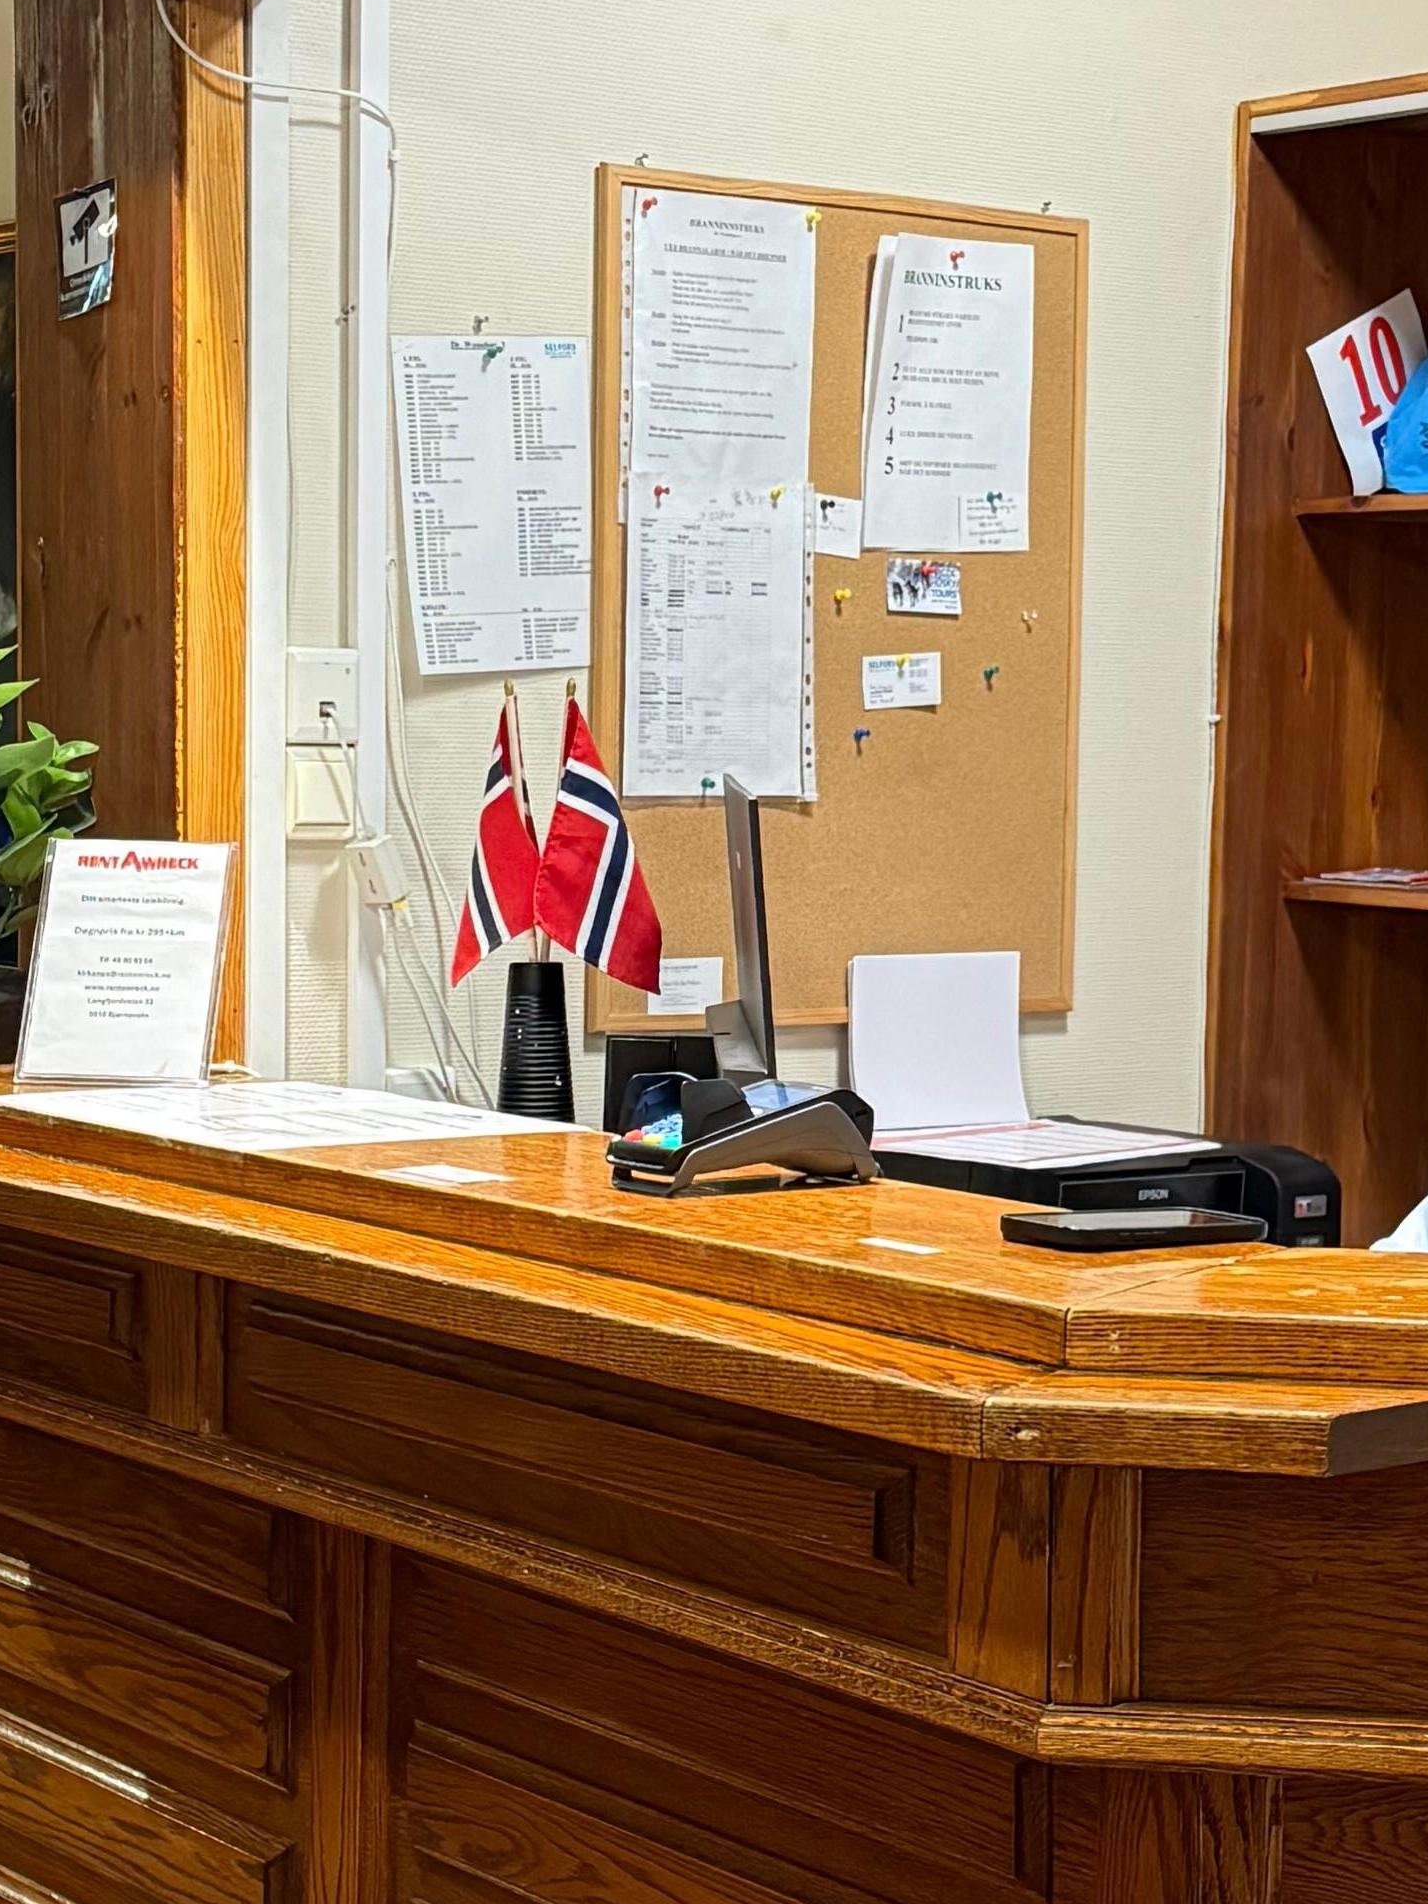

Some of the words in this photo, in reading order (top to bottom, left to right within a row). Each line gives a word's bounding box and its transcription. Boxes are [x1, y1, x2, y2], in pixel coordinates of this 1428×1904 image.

[892, 362, 900, 381] 2
[1340, 316, 1406, 427] 10
[887, 396, 895, 415] 3
[885, 426, 894, 445] 4
[884, 456, 894, 475] 5
[1138, 1189, 1169, 1200] EPSON
